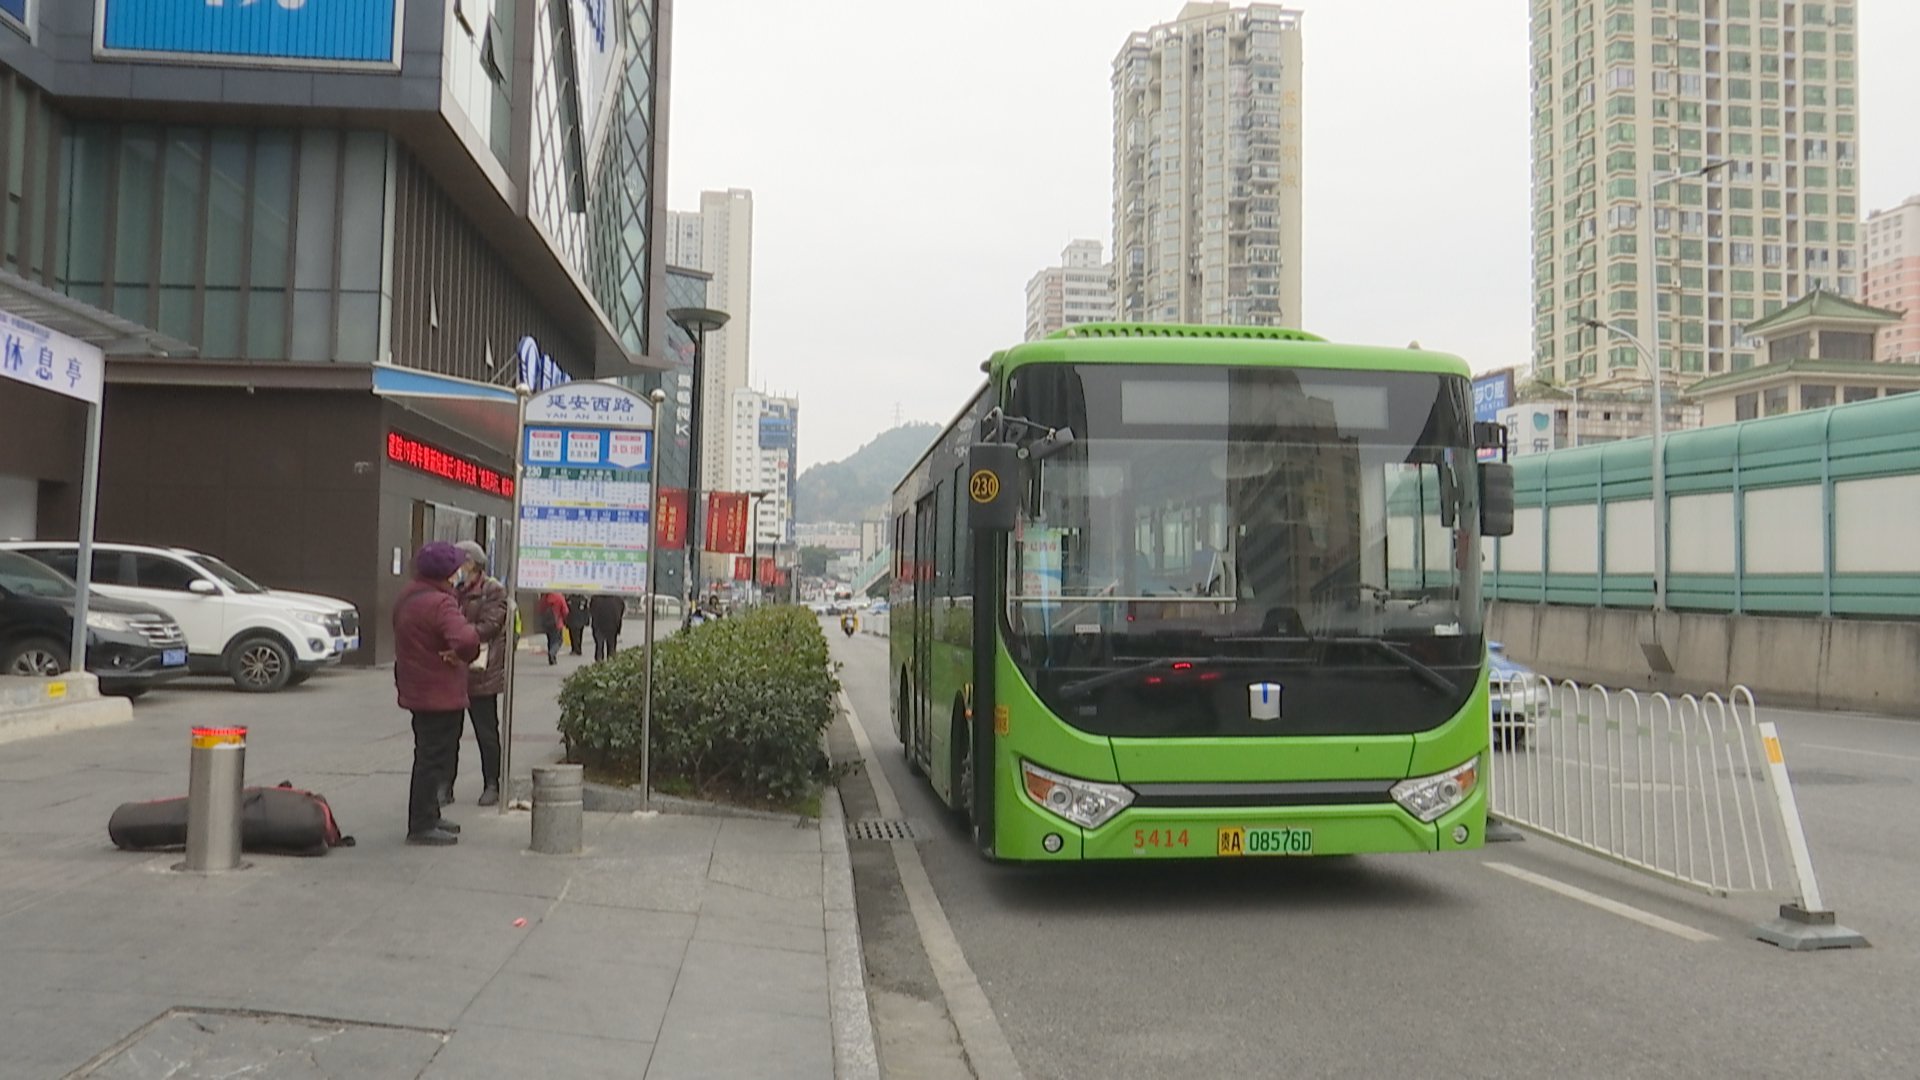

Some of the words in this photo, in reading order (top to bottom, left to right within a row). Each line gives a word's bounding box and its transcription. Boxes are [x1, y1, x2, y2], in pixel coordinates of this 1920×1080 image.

[3, 333, 82, 389] 休息亭
[546, 394, 634, 413] 延安西路
[546, 412, 567, 420] YAN
[525, 466, 542, 478] 230
[974, 477, 996, 496] 230
[1134, 829, 1188, 848] 5414
